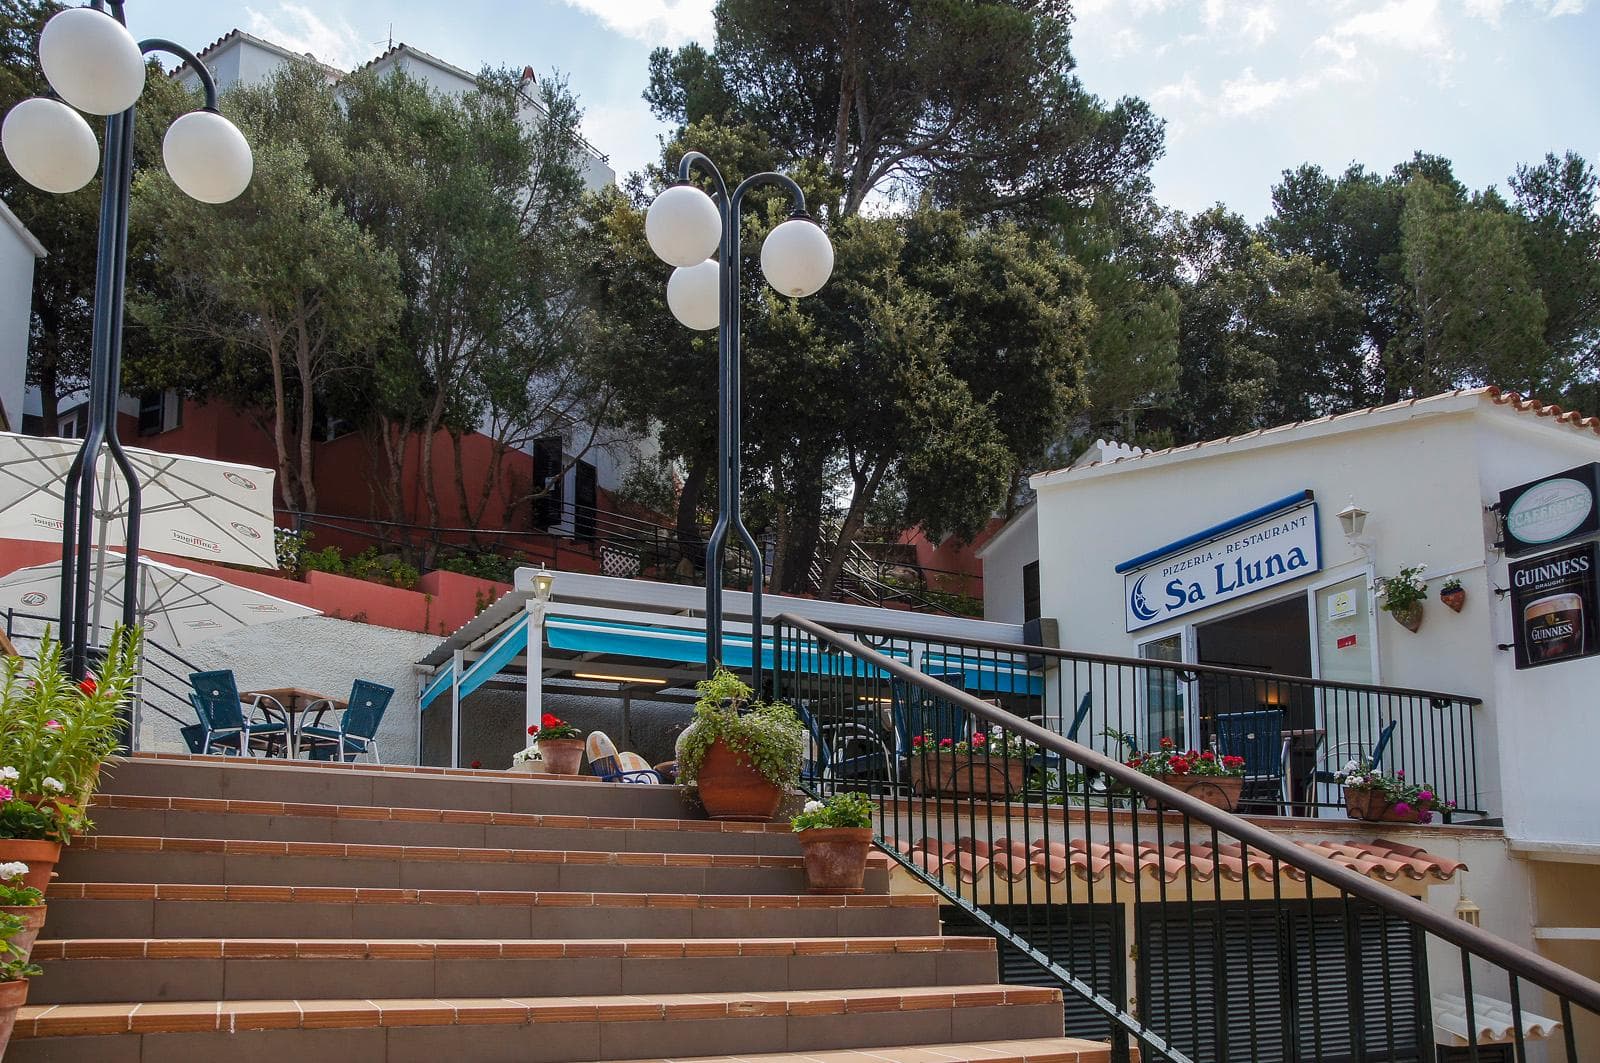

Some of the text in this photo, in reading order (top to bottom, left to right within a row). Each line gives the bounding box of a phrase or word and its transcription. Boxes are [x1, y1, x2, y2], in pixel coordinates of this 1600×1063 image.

[1163, 552, 1213, 577] PIZZERIA
[1226, 516, 1308, 554] RESTAURANT
[1165, 546, 1309, 612] Sa Lluna
[1514, 556, 1589, 588] GUINNESS
[1535, 578, 1565, 590] DRAUGHT
[1531, 623, 1573, 641] GUINNESS
